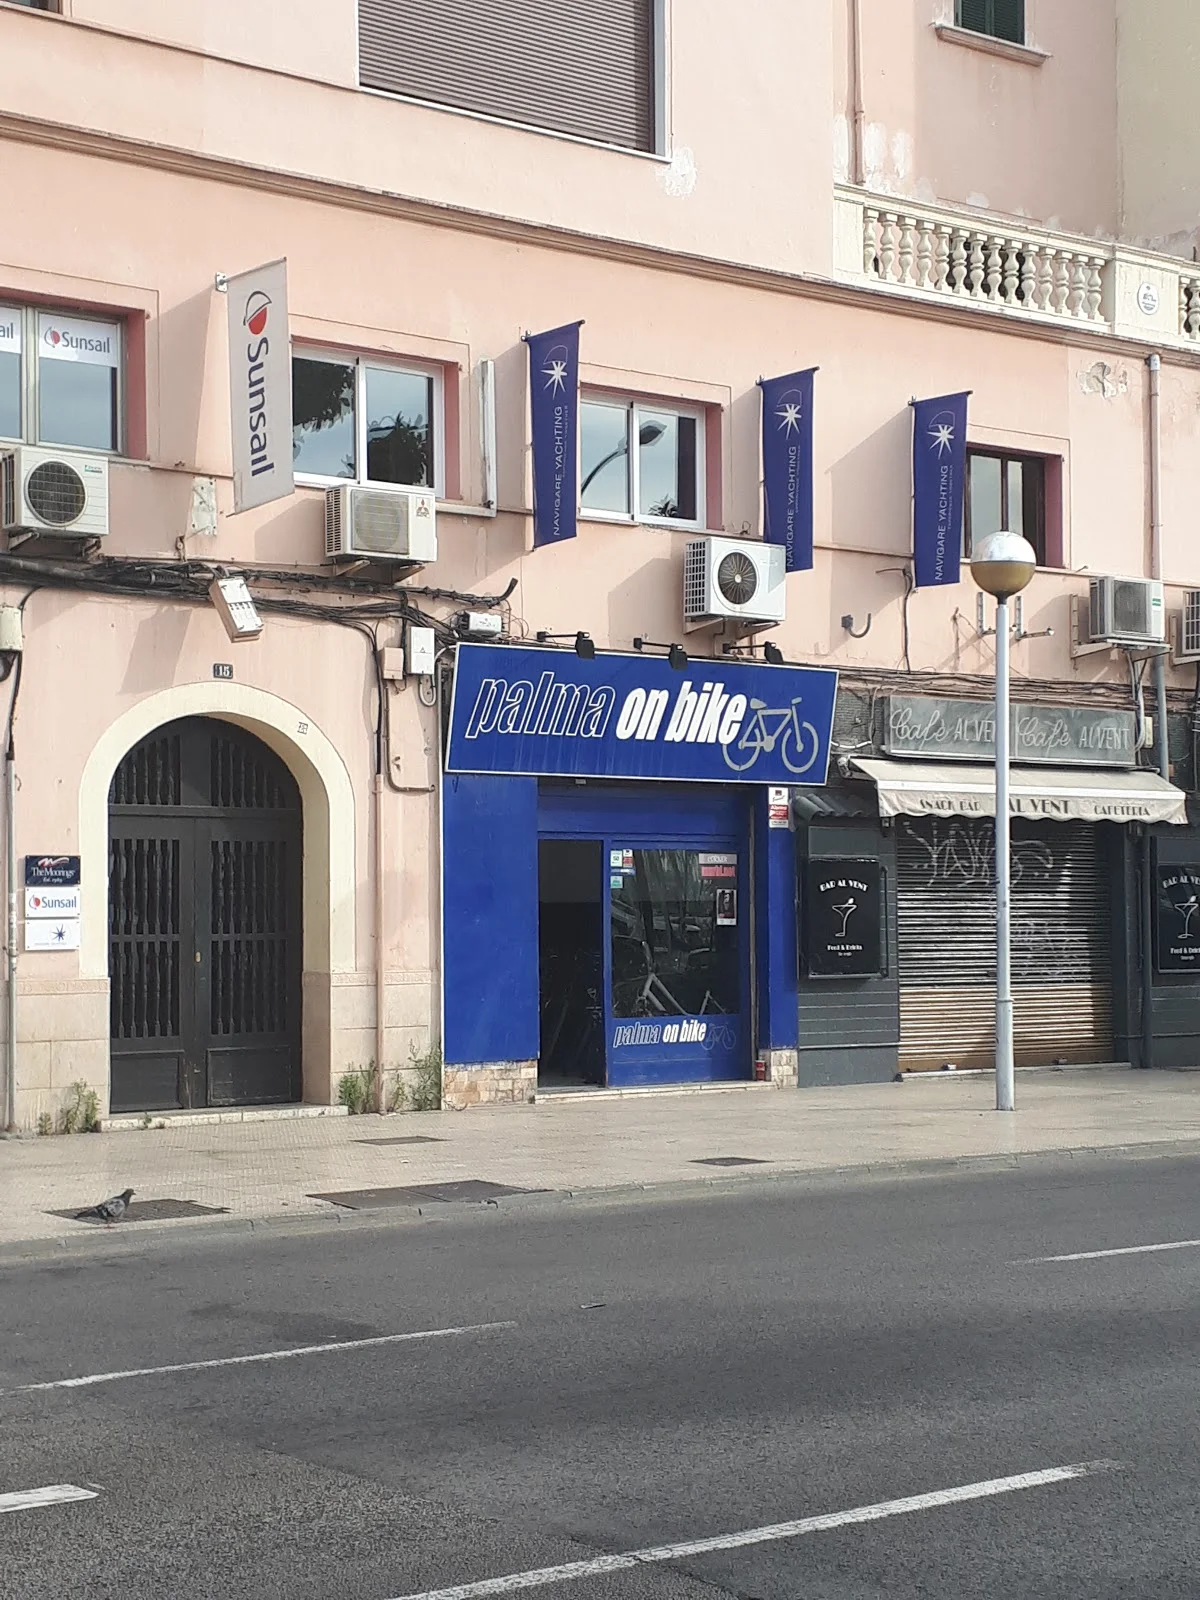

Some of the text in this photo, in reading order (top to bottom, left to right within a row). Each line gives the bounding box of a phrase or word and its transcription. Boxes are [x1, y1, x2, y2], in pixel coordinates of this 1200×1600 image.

[61, 331, 110, 353] Sunsail
[247, 336, 275, 477] Sunsail
[553, 406, 563, 536] NAVIGARE YACHTING
[786, 446, 797, 567] NAVIGARE YACHTING
[934, 465, 949, 581] NAVIGARE YACHTING
[218, 665, 230, 677] 15
[464, 671, 748, 745] palma on bike
[953, 717, 969, 741] AL
[1079, 726, 1094, 748] AL
[1096, 726, 1130, 750] VENT
[920, 799, 954, 811] SNACK
[959, 800, 981, 811] BAR
[1029, 798, 1070, 814] VENT
[1094, 805, 1151, 816] CAFETERIA
[820, 879, 868, 892] BAR AL VENT
[41, 895, 77, 909] Sunsail
[613, 1019, 707, 1048] palma on bike
